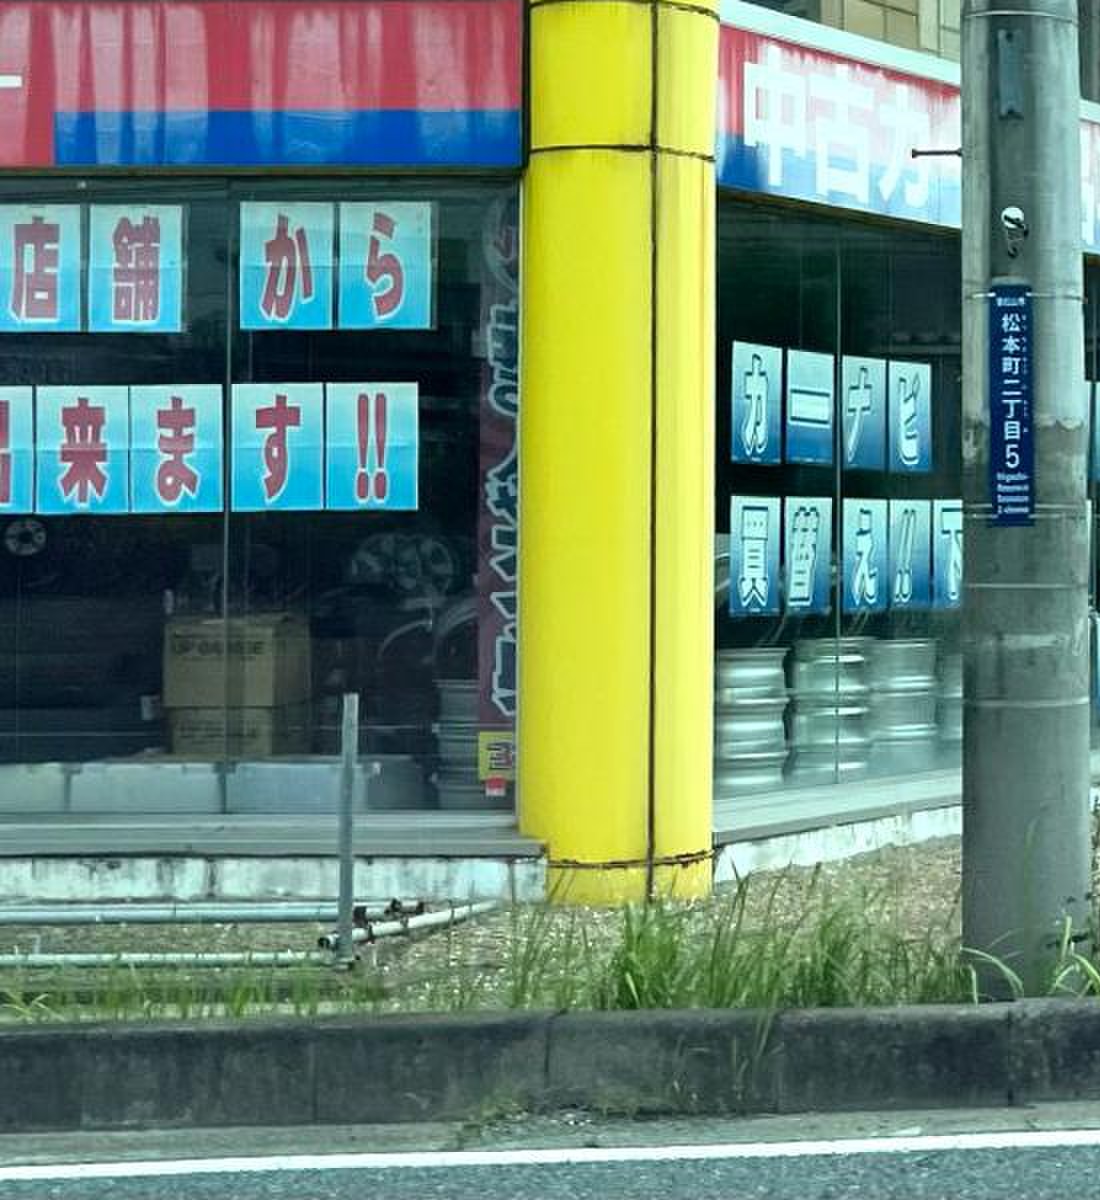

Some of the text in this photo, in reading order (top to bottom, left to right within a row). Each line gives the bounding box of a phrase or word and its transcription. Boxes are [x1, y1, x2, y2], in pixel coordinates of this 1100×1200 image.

[0, 392, 389, 508] 来ます!!
[744, 353, 921, 466] カーナビ
